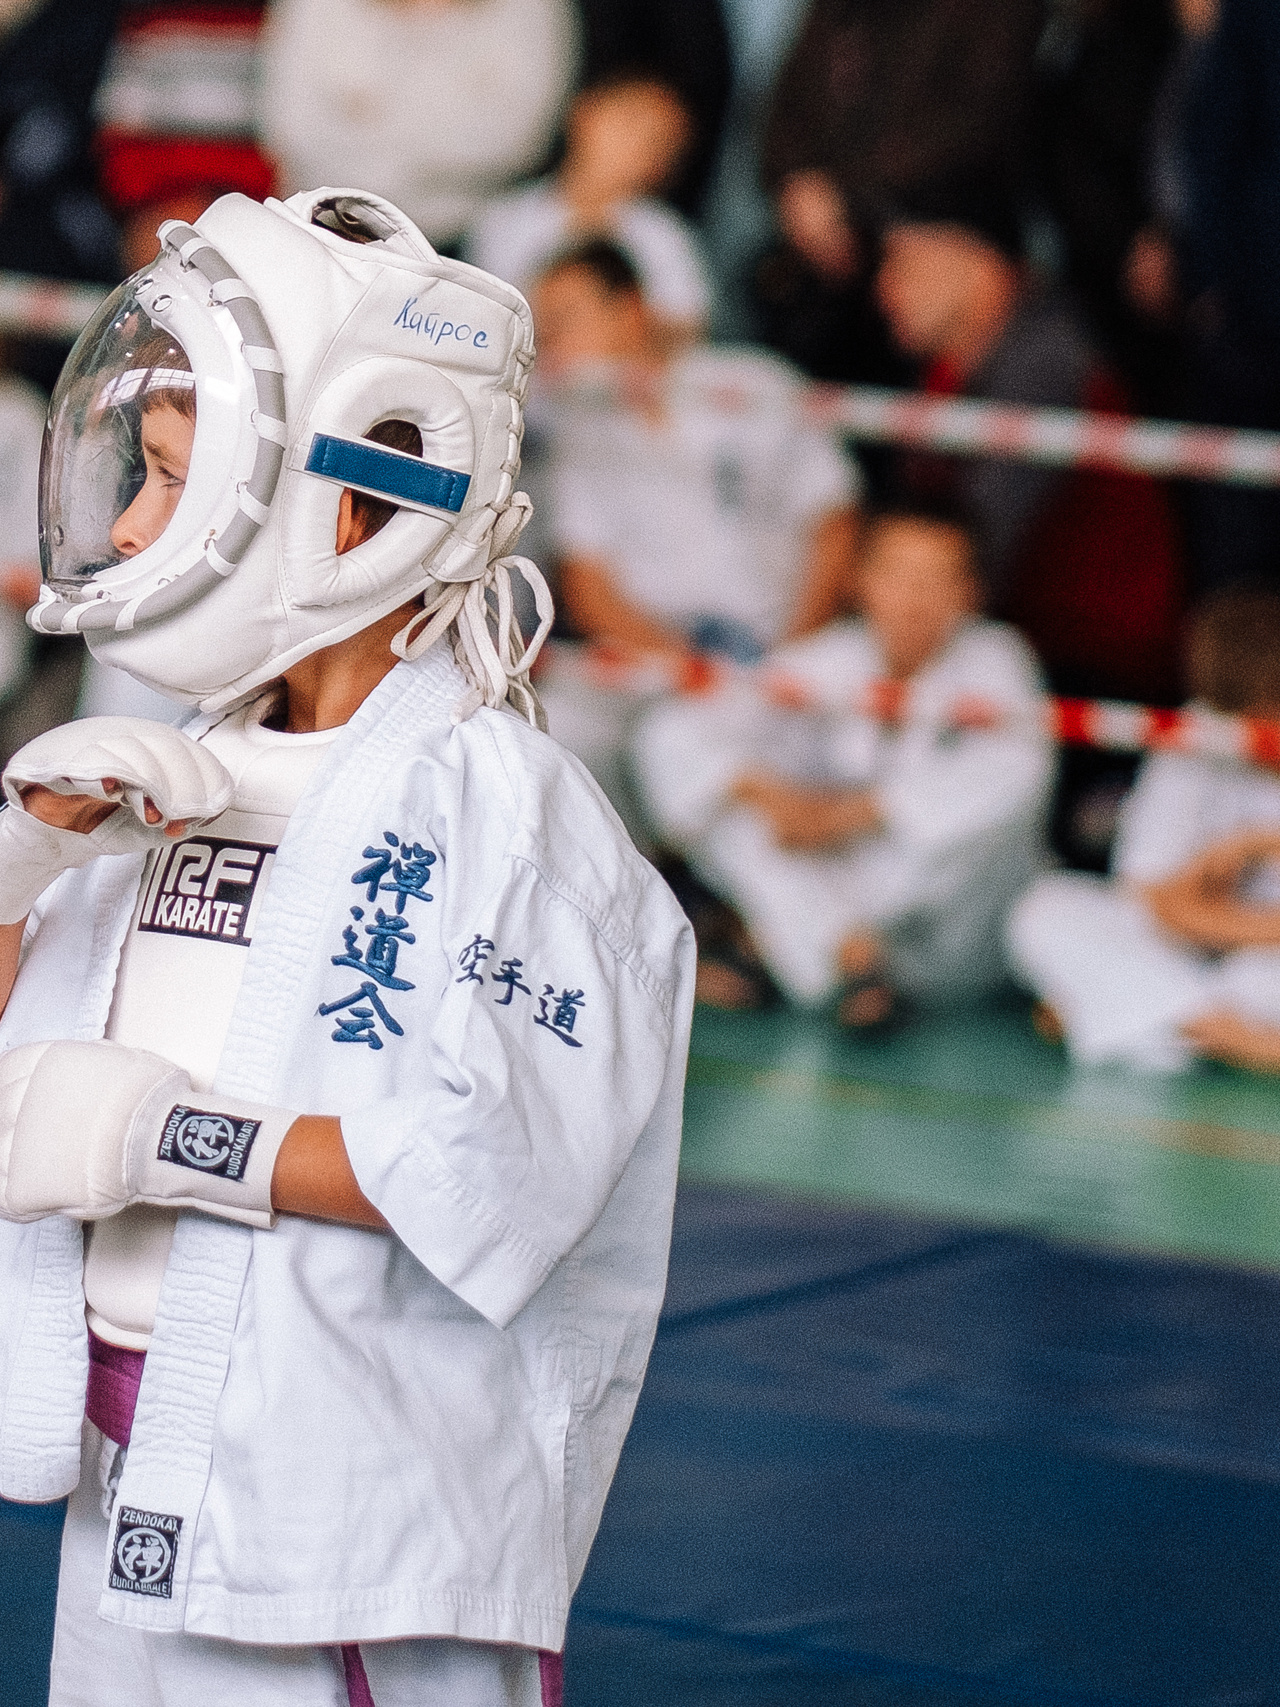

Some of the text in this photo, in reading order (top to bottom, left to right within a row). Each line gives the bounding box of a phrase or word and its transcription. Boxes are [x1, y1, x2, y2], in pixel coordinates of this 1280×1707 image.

[154, 894, 244, 936] KARATE
[456, 933, 586, 1048] 空手道
[160, 1107, 189, 1158] ZENDOKA
[121, 1508, 178, 1532] ZENDOKAI
